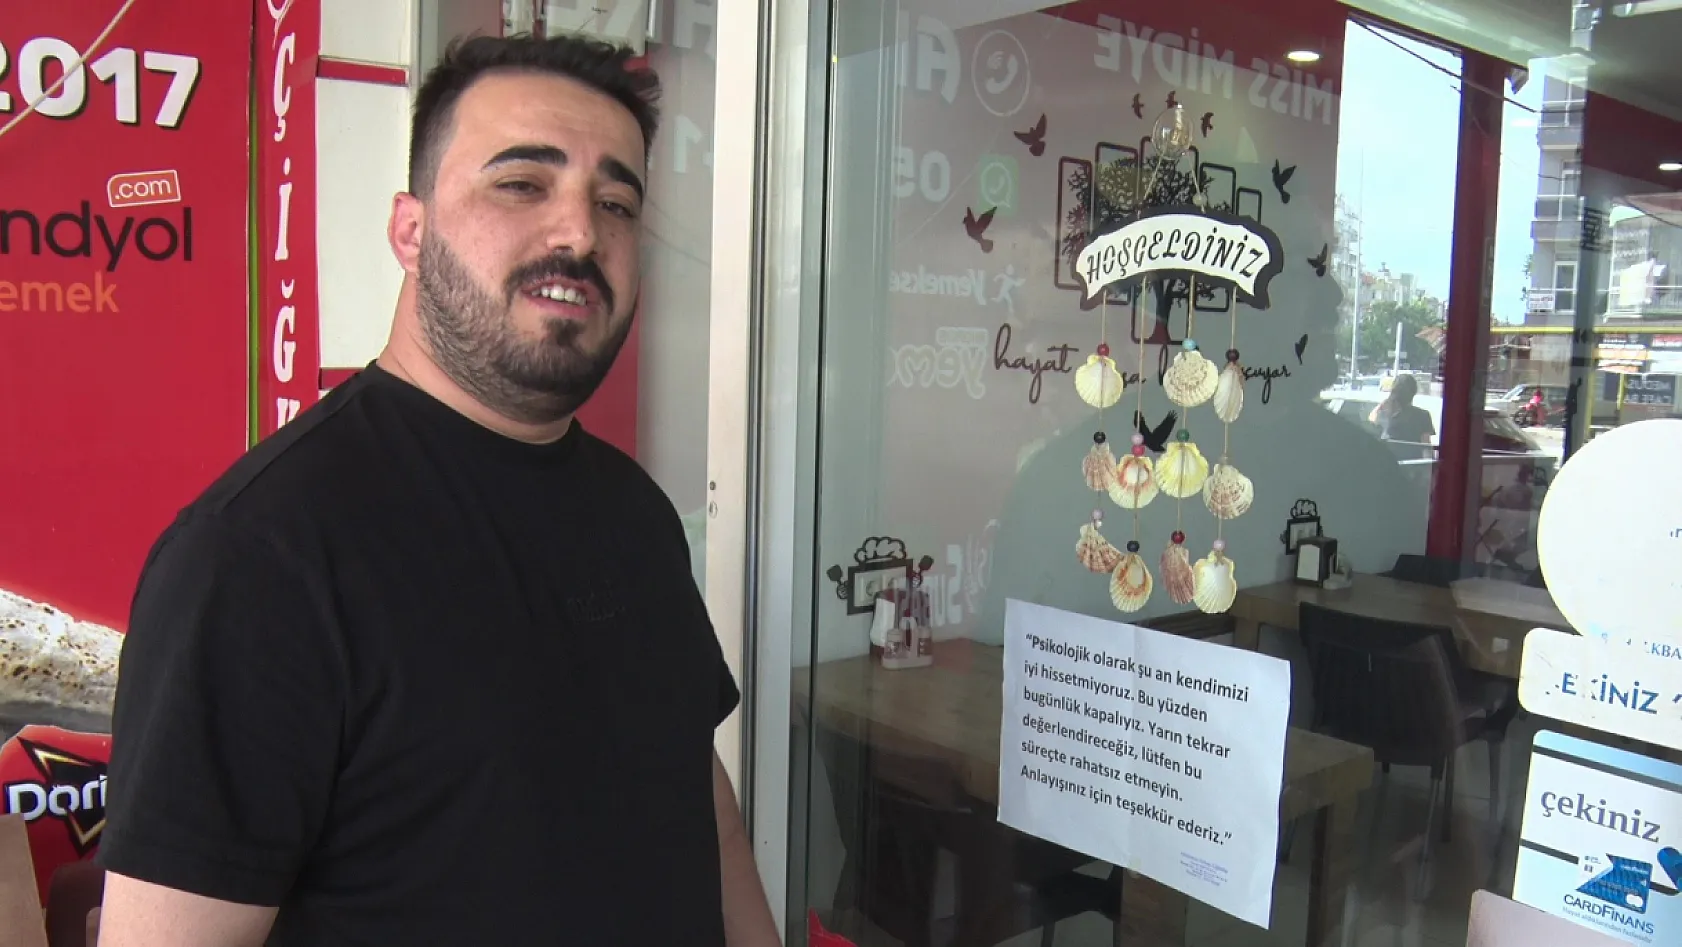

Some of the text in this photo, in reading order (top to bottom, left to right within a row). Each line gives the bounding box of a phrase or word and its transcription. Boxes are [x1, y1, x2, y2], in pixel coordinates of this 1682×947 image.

[0, 36, 200, 128] 017
[113, 177, 172, 200] .com
[0, 201, 193, 272] ndyol
[1086, 227, 1264, 285] HOŞGELDİNİZ
[995, 322, 1079, 404] hayat
[1024, 660, 1208, 724] iyi hissetmiyoruz. Bu yüzden
[1093, 651, 1135, 673] olarak
[1137, 662, 1152, 679] şu
[1155, 668, 1172, 683] an
[1176, 670, 1249, 703] kendimizi
[1022, 713, 1203, 781] değerlendireceğiz, lütfen bu
[1023, 686, 1231, 759] bugünlük kapalıyız. Yarın tekrar
[1020, 764, 1087, 797] Anlayışınız
[1089, 787, 1113, 805] için
[1115, 796, 1174, 826] teşekkür
[1021, 739, 1183, 802] süreçte rahatsız etmeyin.
[1540, 791, 1661, 843] çekiniz
